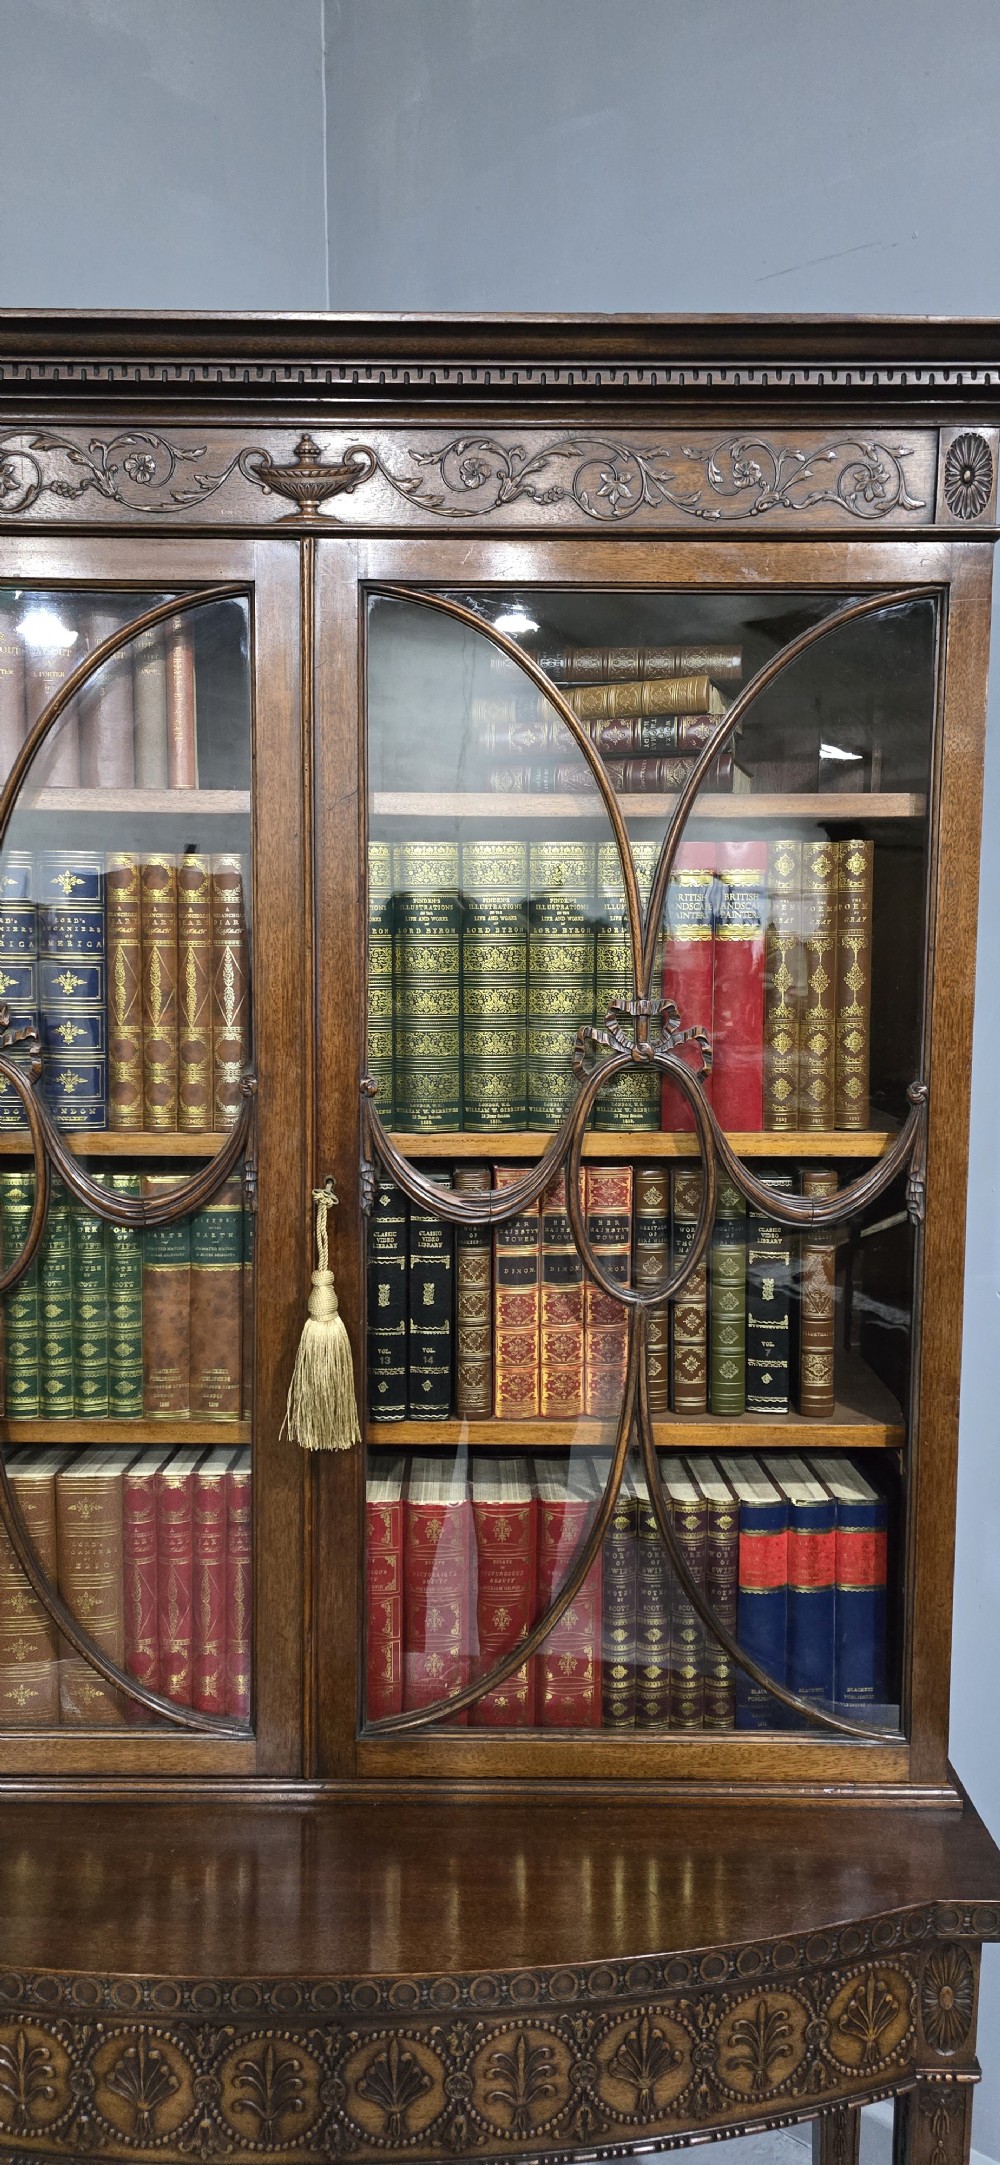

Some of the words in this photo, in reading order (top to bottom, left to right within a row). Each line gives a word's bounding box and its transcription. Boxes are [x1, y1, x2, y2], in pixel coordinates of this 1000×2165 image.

[676, 893, 707, 902] RITISH
[724, 892, 758, 901] BRITISH
[676, 911, 709, 919] AINTERS
[112, 1242, 138, 1250] WIFT
[765, 1348, 772, 1357] 7
[380, 1356, 391, 1365] 13
[422, 1356, 434, 1364] 14
